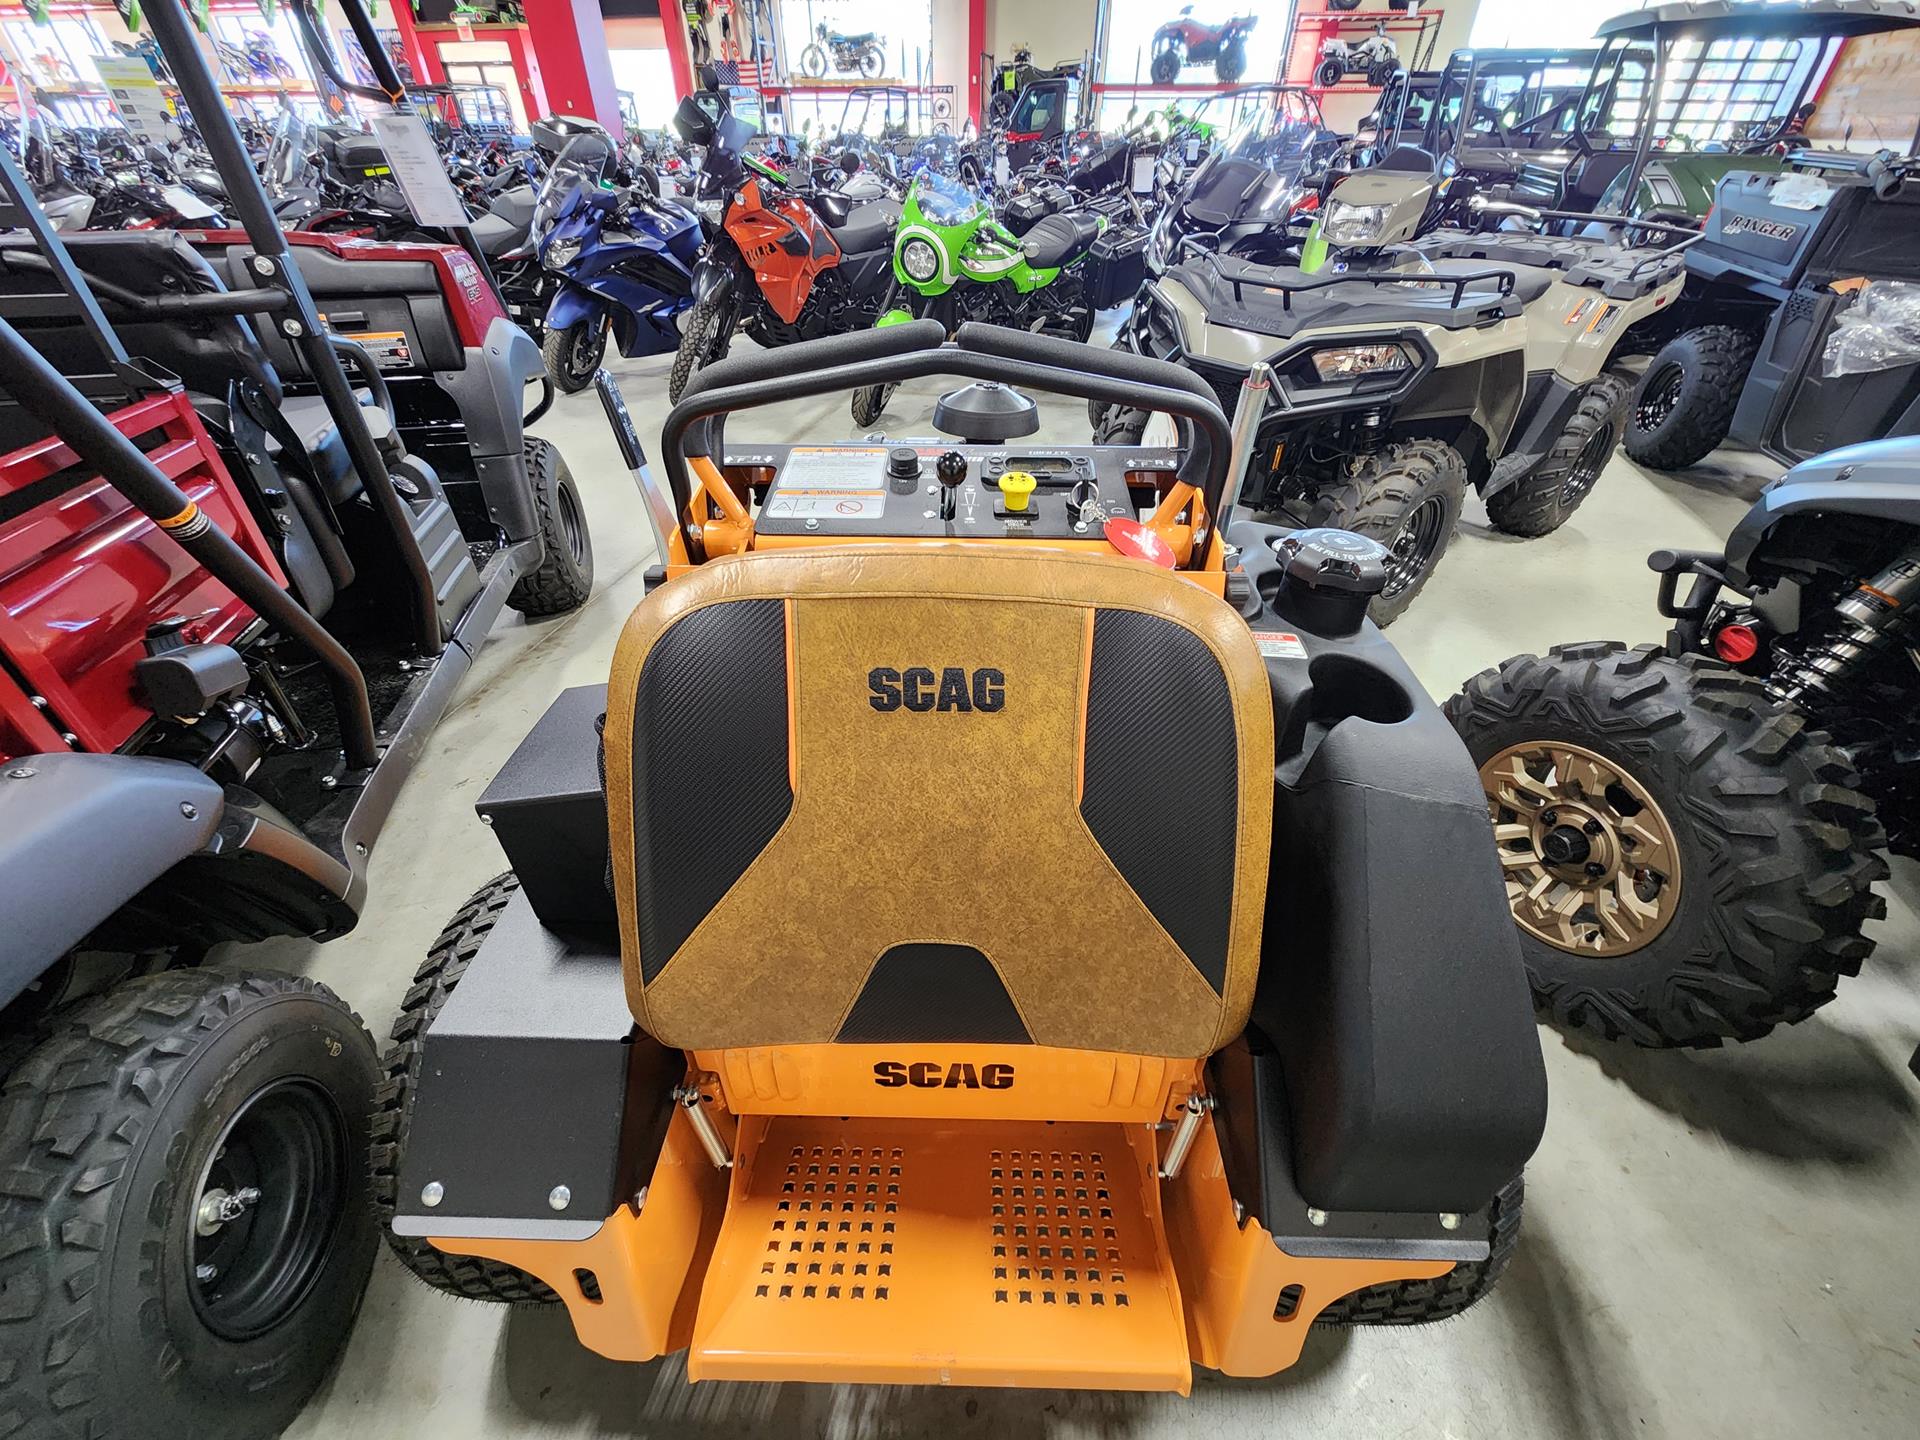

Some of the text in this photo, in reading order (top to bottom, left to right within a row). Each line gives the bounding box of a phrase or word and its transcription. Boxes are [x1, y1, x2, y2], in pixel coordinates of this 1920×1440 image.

[1730, 215, 1796, 241] RANGER
[1323, 549, 1341, 559] FILL
[1342, 553, 1355, 561] TO
[1254, 633, 1284, 641] ANGER
[868, 667, 1006, 713] SCAG
[873, 1061, 1015, 1090] SCAG
